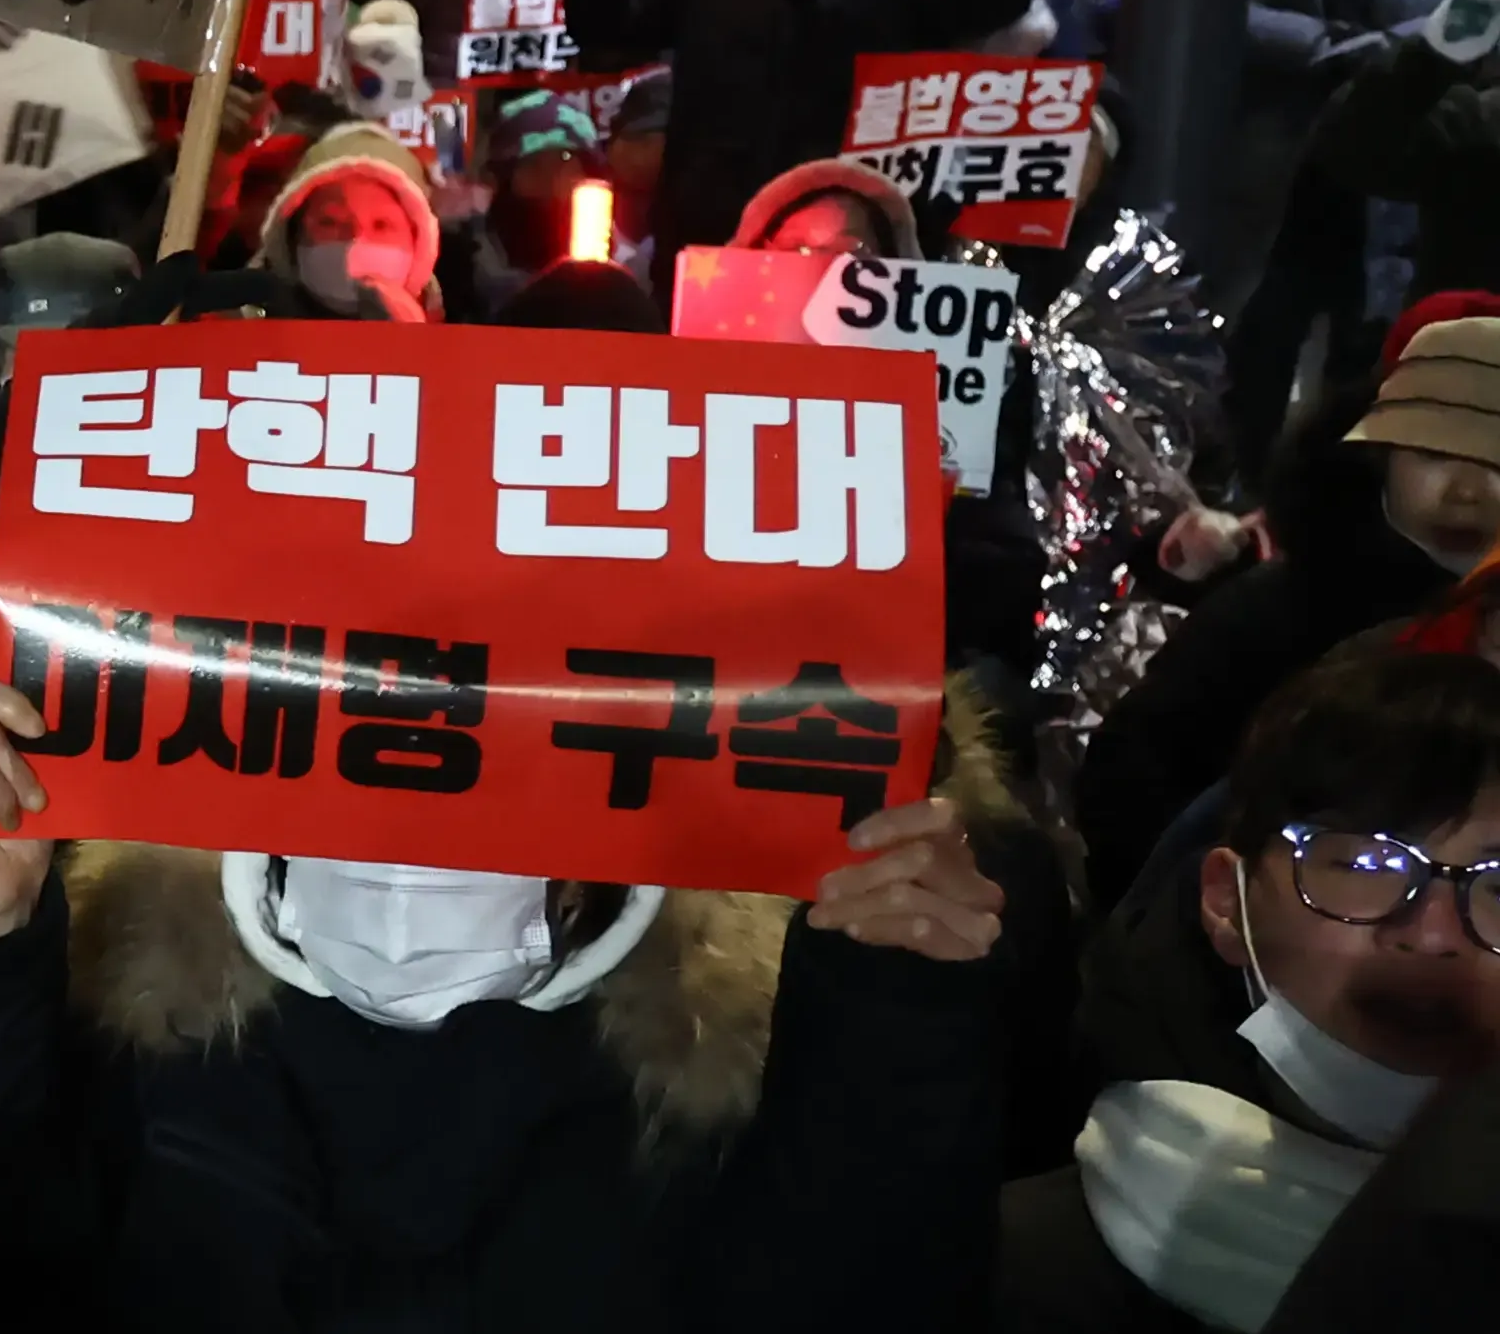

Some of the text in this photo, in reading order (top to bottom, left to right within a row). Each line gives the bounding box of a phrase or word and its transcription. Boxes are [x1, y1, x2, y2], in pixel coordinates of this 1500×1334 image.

[852, 65, 1095, 146] 불법영장
[836, 255, 1017, 359] Stop
[30, 360, 908, 573] 탄핵 반대
[9, 601, 904, 831] 이재명 구속
